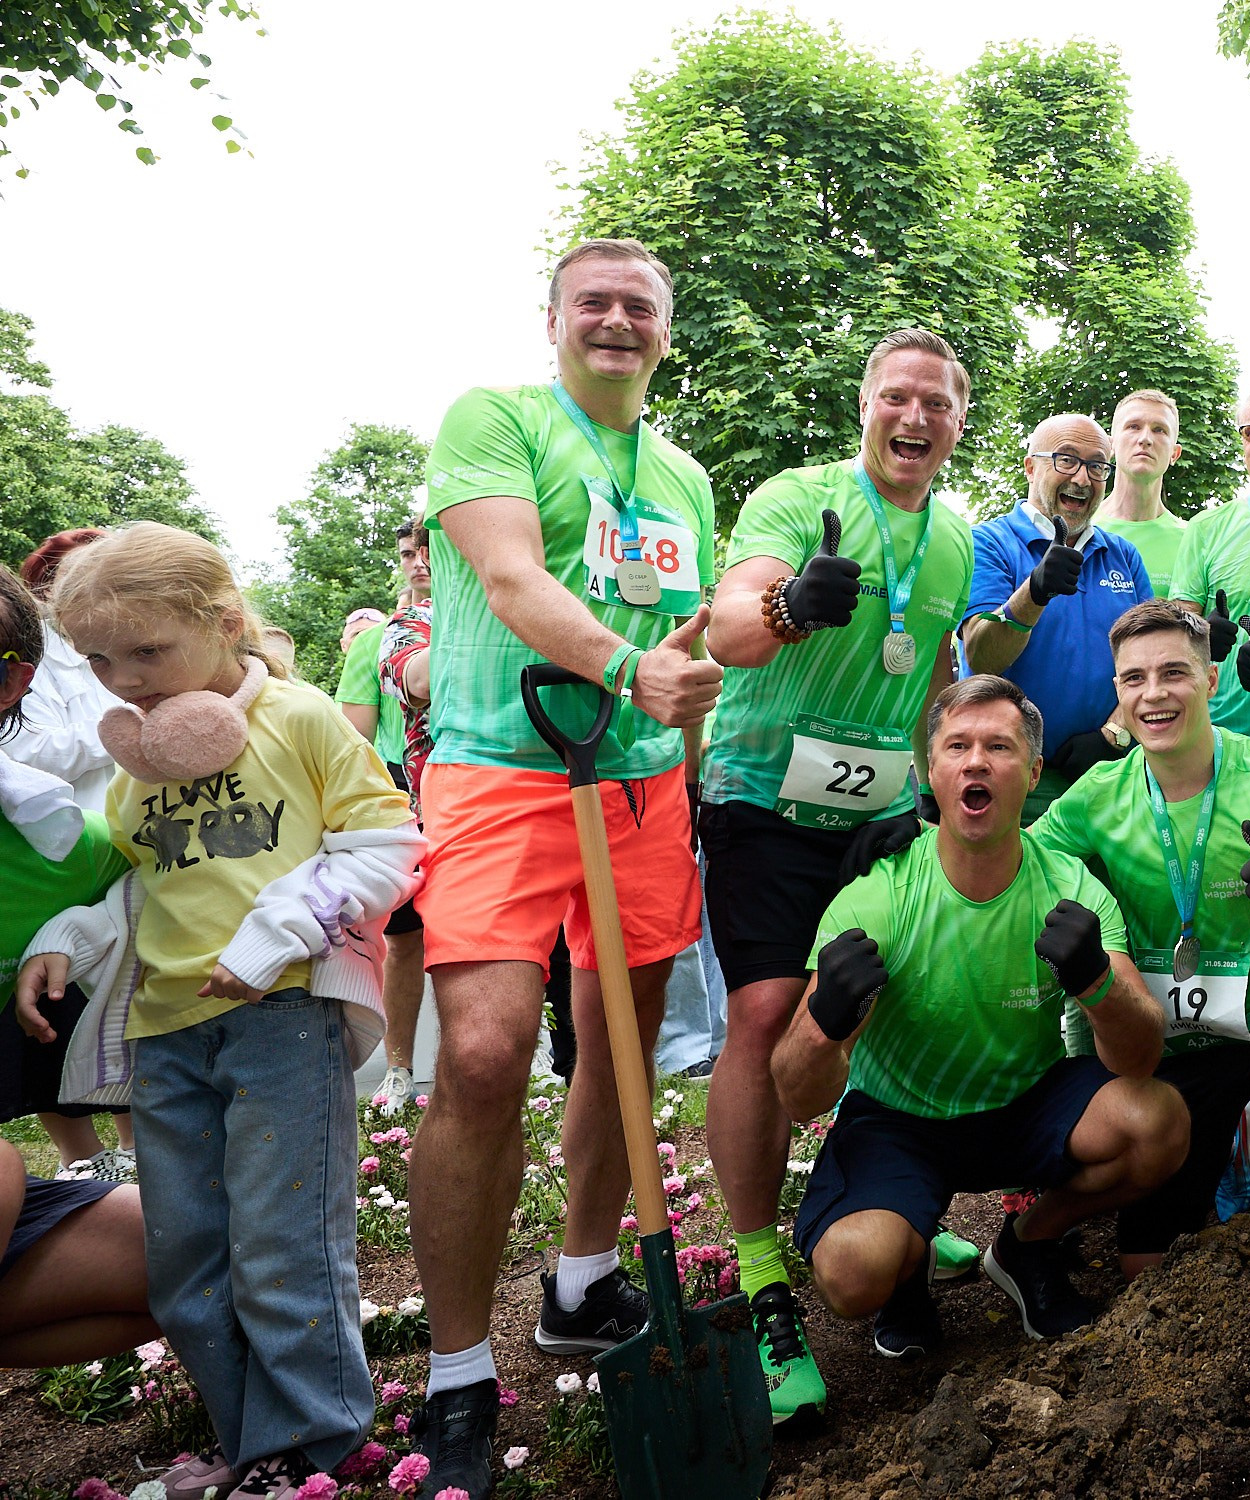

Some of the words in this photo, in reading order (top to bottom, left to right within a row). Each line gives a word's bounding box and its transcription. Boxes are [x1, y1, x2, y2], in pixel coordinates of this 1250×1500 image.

[881, 527, 891, 545] 2025
[590, 574, 601, 596] А
[860, 583, 888, 600] МАЕ
[921, 604, 953, 619] марафо
[825, 761, 876, 798] 22
[782, 803, 797, 821] А
[1161, 828, 1172, 848] 2025
[1195, 827, 1206, 847] 2025
[1209, 877, 1248, 890] зелён
[1204, 887, 1247, 900] мараф
[1204, 960, 1238, 968] 31.05.2025
[1168, 986, 1208, 1022] 19
[1170, 1020, 1214, 1032] НИКИТА
[444, 1410, 471, 1422] MBT
